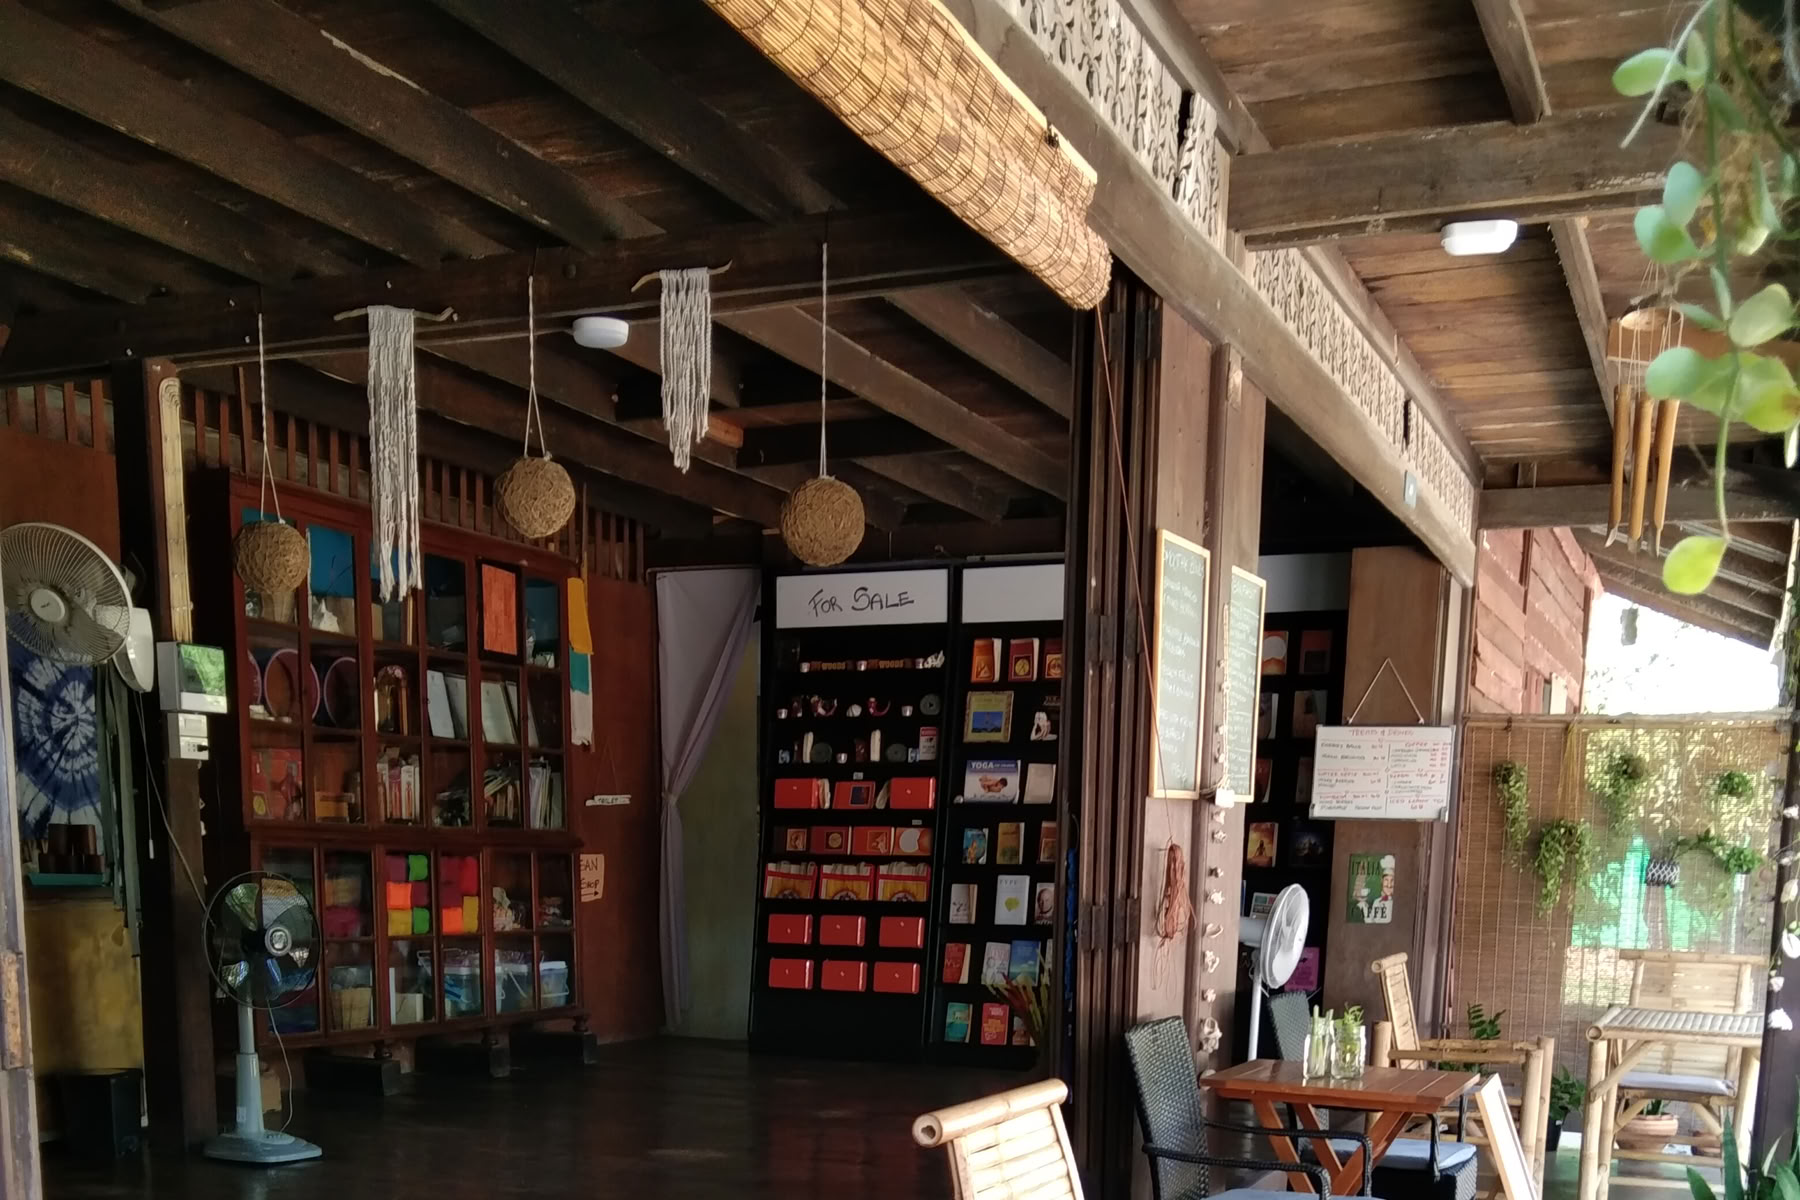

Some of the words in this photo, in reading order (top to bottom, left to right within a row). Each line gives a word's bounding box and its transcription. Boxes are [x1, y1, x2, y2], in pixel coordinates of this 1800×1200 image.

[808, 588, 843, 618] FOR
[851, 586, 915, 612] SALE
[971, 761, 994, 769] YOGA
[1351, 861, 1380, 876] ITALIA
[1351, 903, 1387, 919] CAFFÈ
